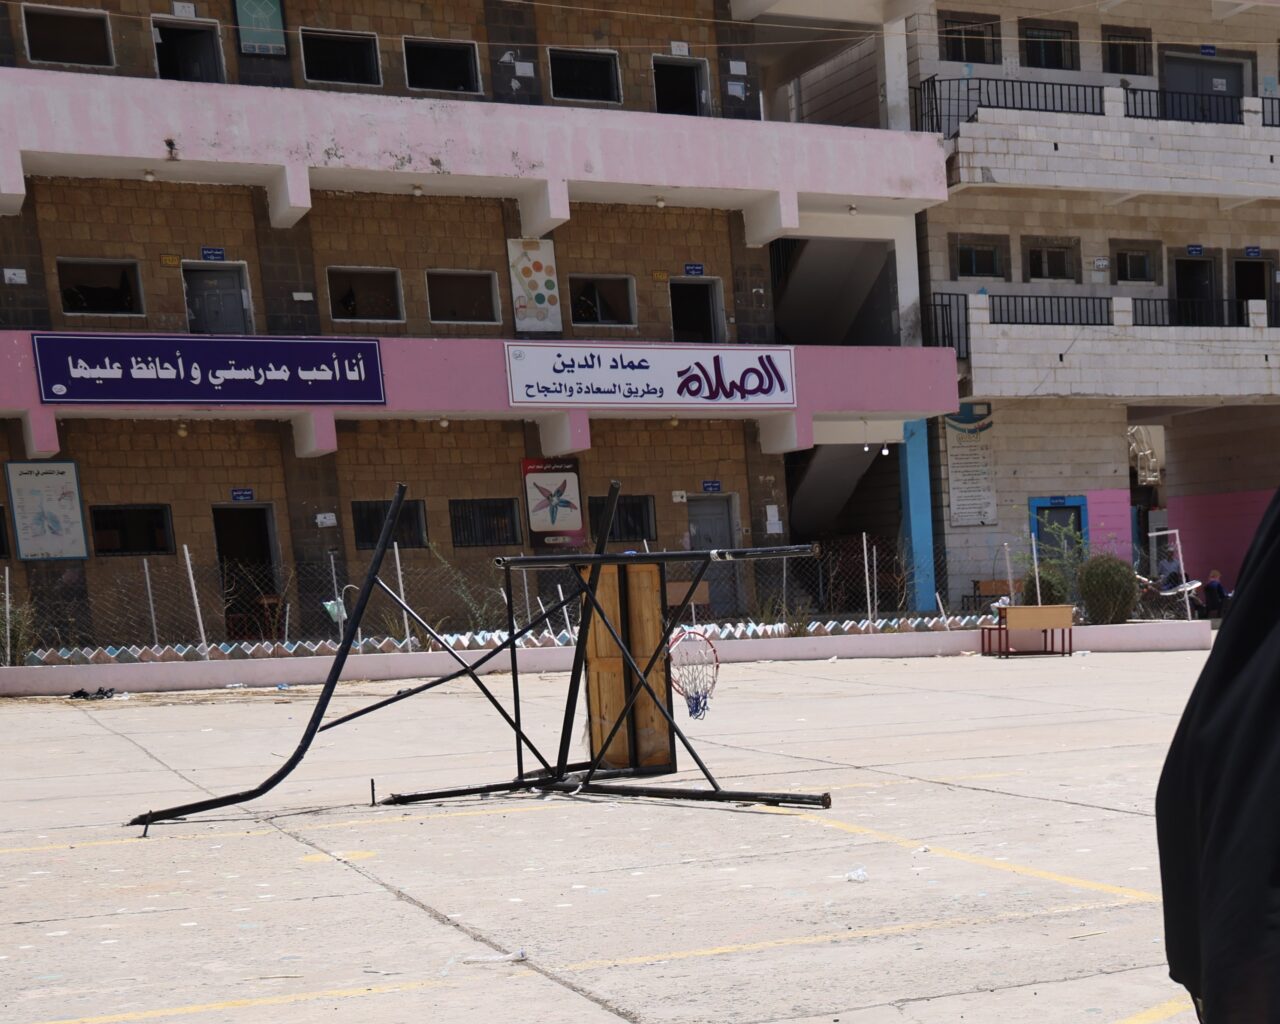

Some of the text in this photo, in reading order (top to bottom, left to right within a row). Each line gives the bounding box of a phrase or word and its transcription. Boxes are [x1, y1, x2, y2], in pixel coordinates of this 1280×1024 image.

[68, 350, 366, 389] أنا أحب مدرستي و أحافظ عليها
[552, 353, 650, 373] عماد الدين
[676, 354, 787, 401] الصلاة
[525, 380, 664, 399] وطريق السعادة والنجاح
